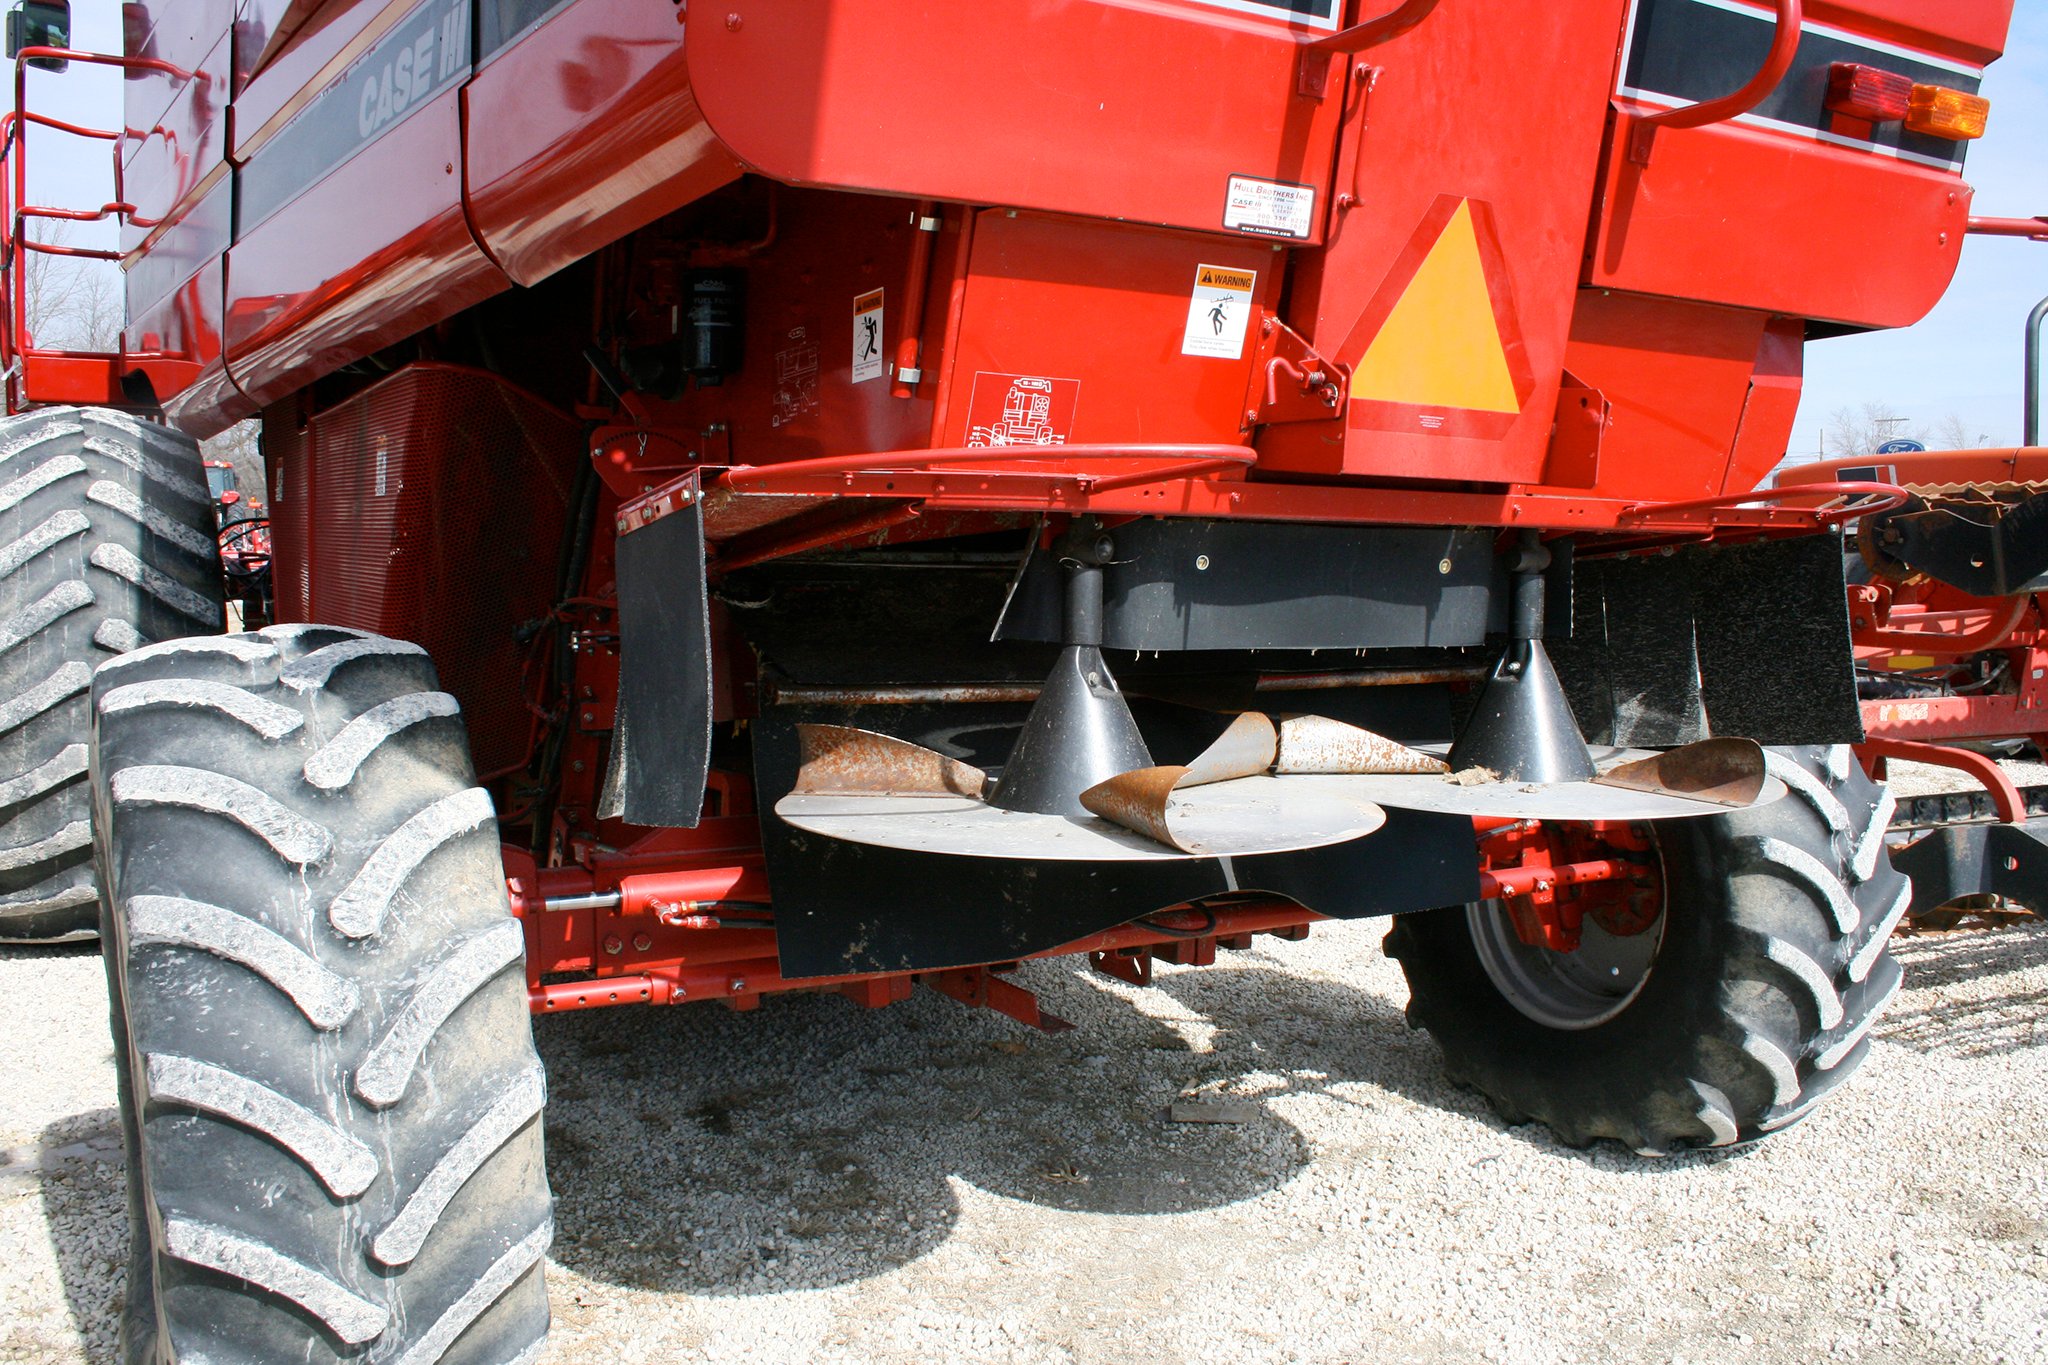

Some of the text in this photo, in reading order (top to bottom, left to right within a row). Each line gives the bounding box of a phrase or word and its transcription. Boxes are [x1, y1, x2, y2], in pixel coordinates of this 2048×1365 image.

[359, 27, 435, 138] CASE
[1234, 183, 1254, 193] HULL
[1256, 185, 1295, 199] BROTHERS
[1232, 198, 1253, 206] CASE
[1214, 274, 1252, 288] WARNING
